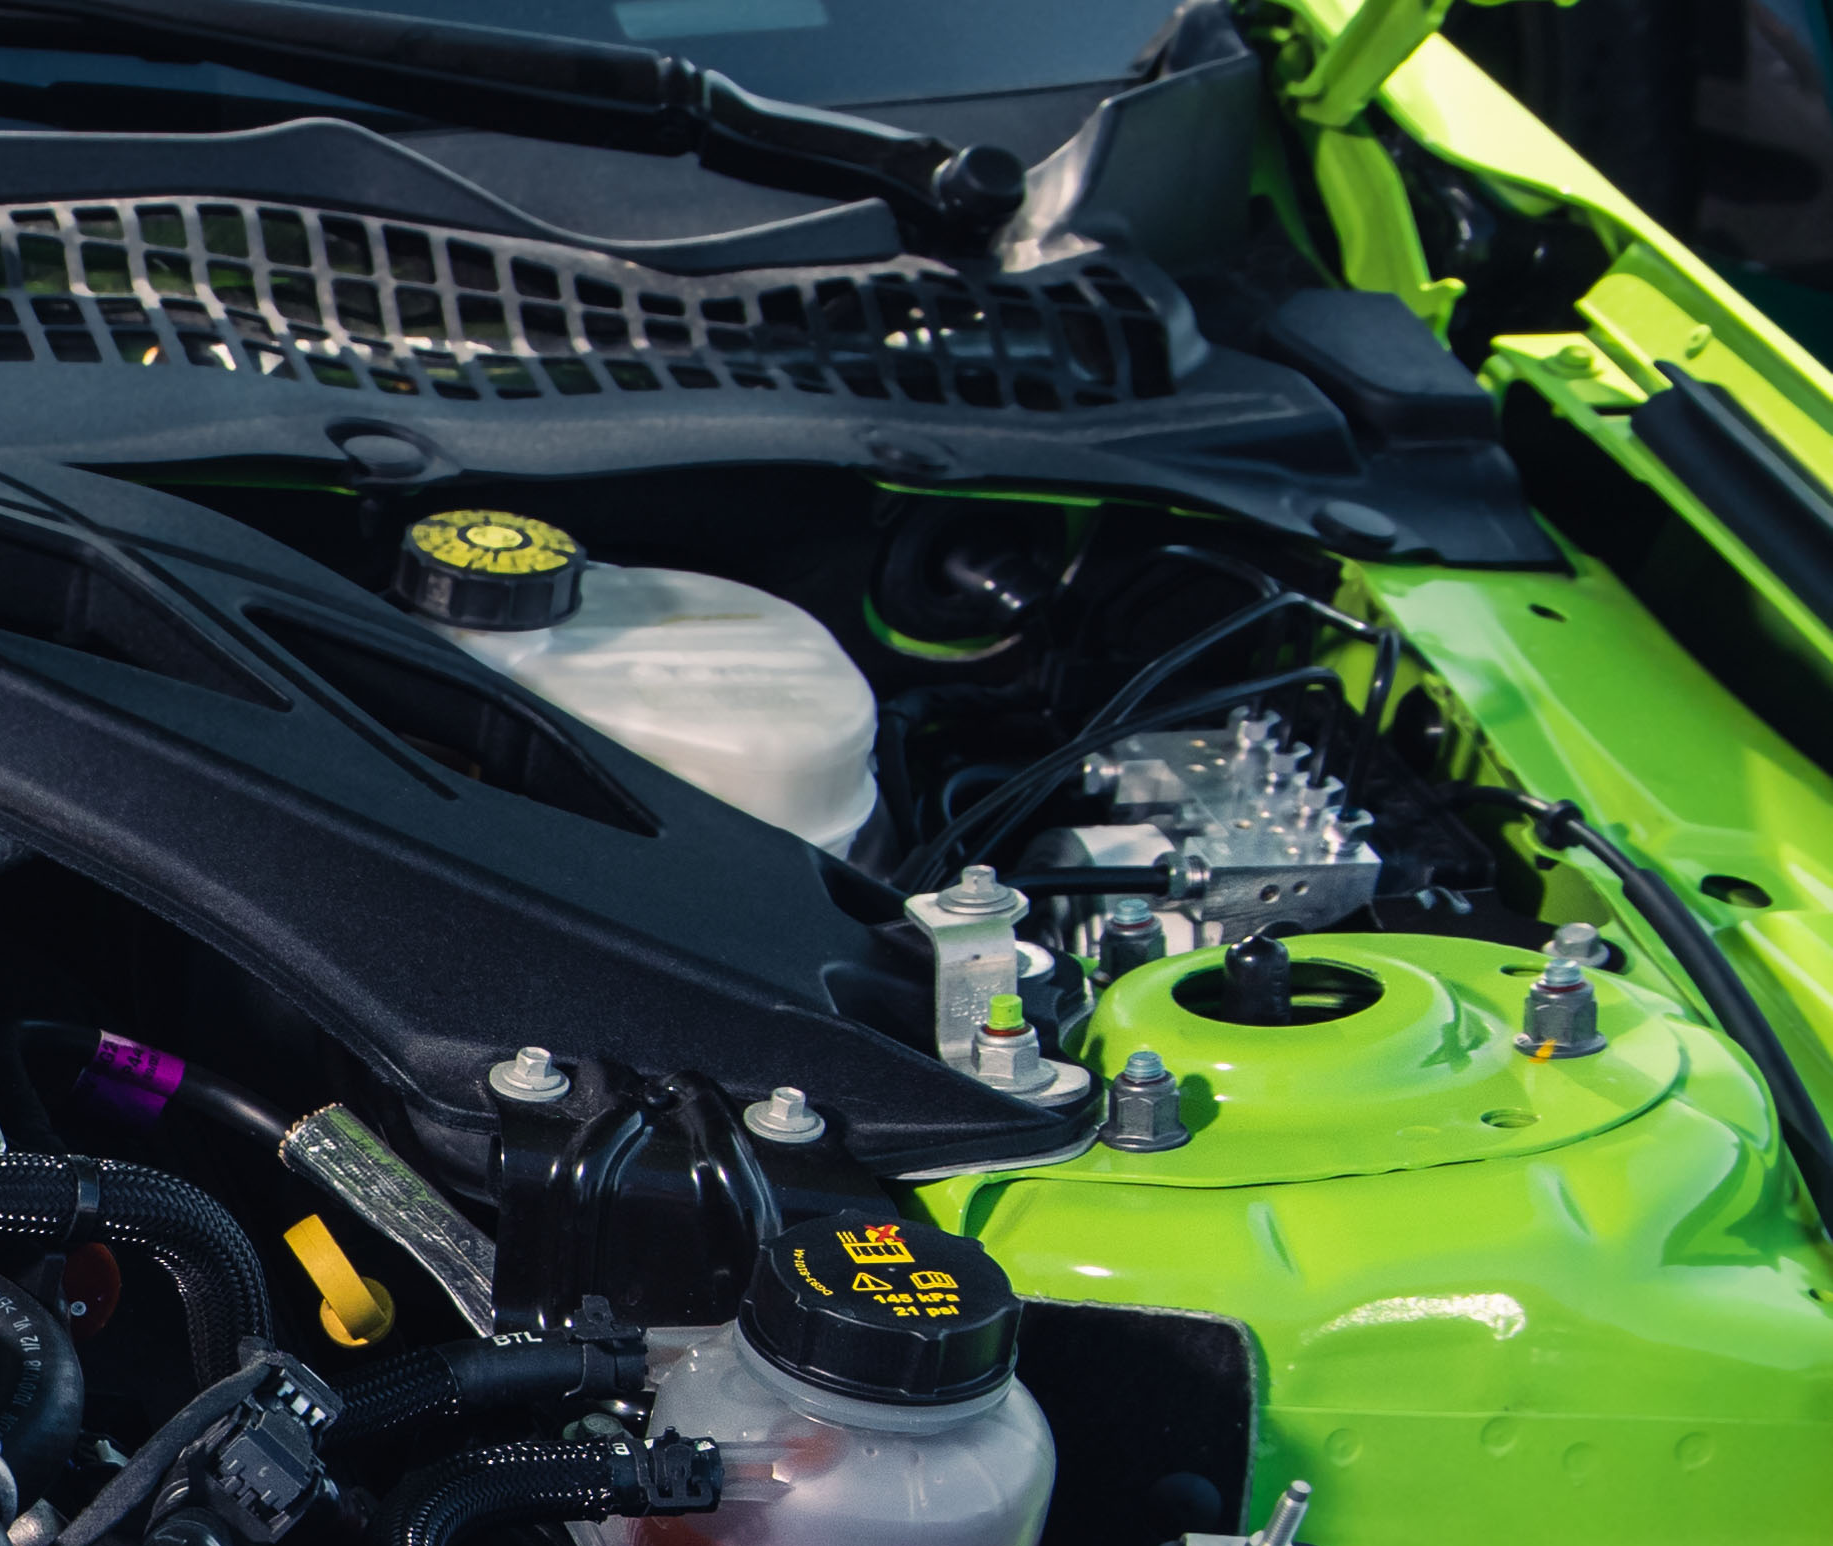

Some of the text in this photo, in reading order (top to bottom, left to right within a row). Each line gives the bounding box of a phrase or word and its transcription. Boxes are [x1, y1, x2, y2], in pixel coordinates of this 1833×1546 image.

[873, 1292, 960, 1305] 145 kPa
[893, 1305, 960, 1318] 21 psi
[492, 1331, 543, 1347] BTL
